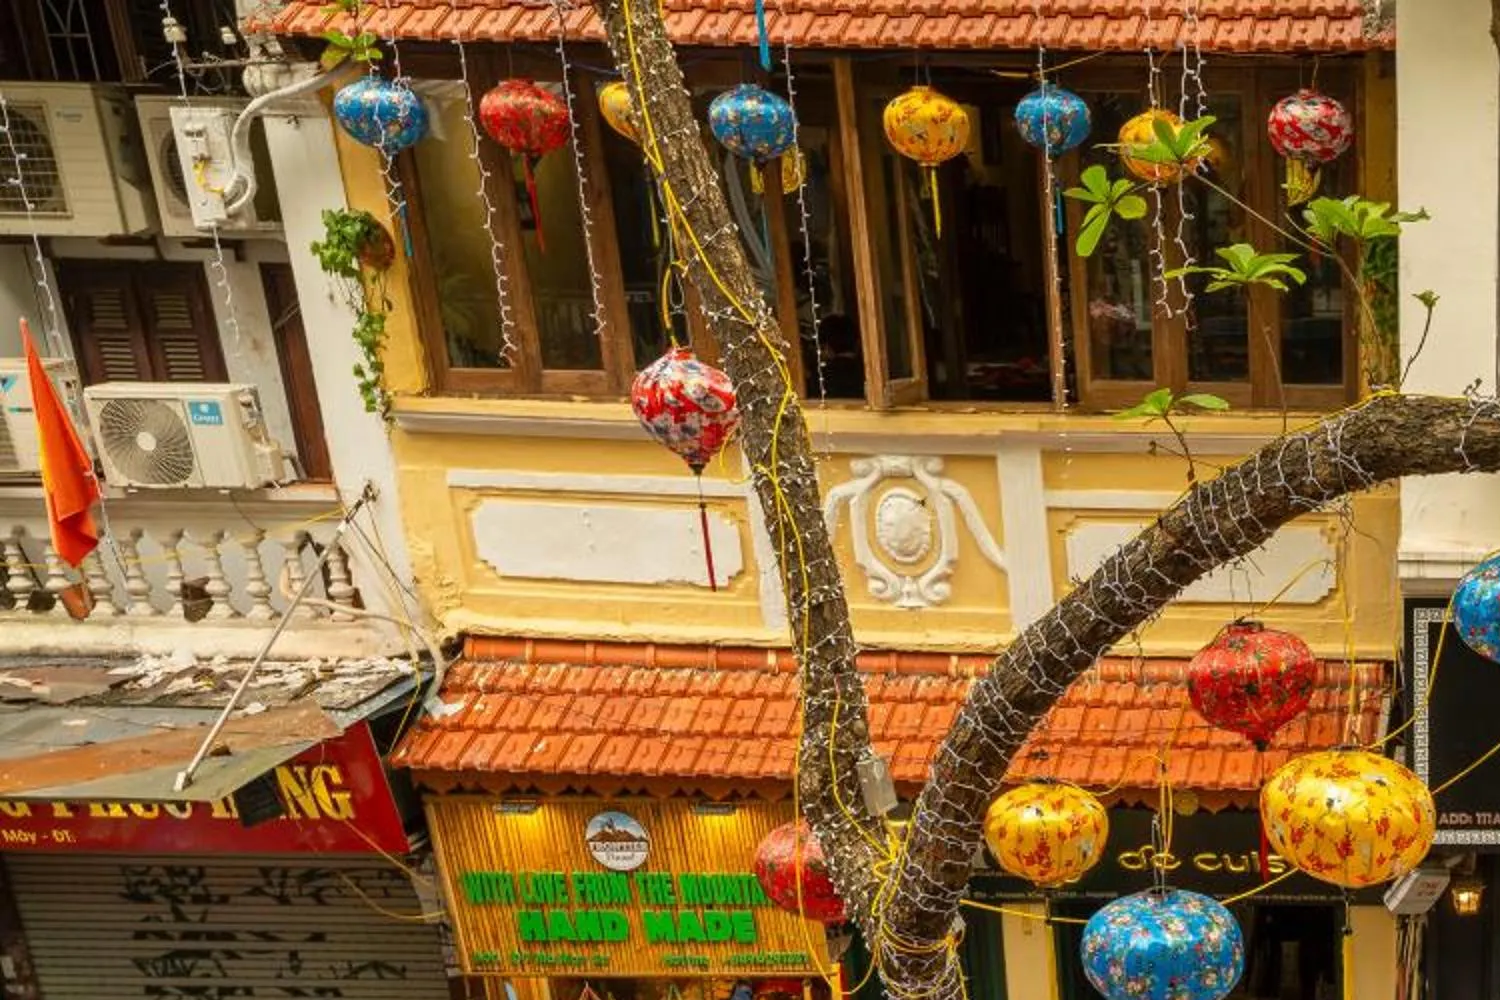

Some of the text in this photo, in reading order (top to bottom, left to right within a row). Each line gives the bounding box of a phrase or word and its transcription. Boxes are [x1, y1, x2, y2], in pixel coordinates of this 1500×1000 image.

[1118, 845, 1288, 874] de cuis
[463, 871, 514, 905] WITH
[519, 871, 569, 905] LOVE
[572, 871, 631, 905] FROM
[635, 871, 675, 905] THE
[517, 909, 759, 944] HAND MADE
